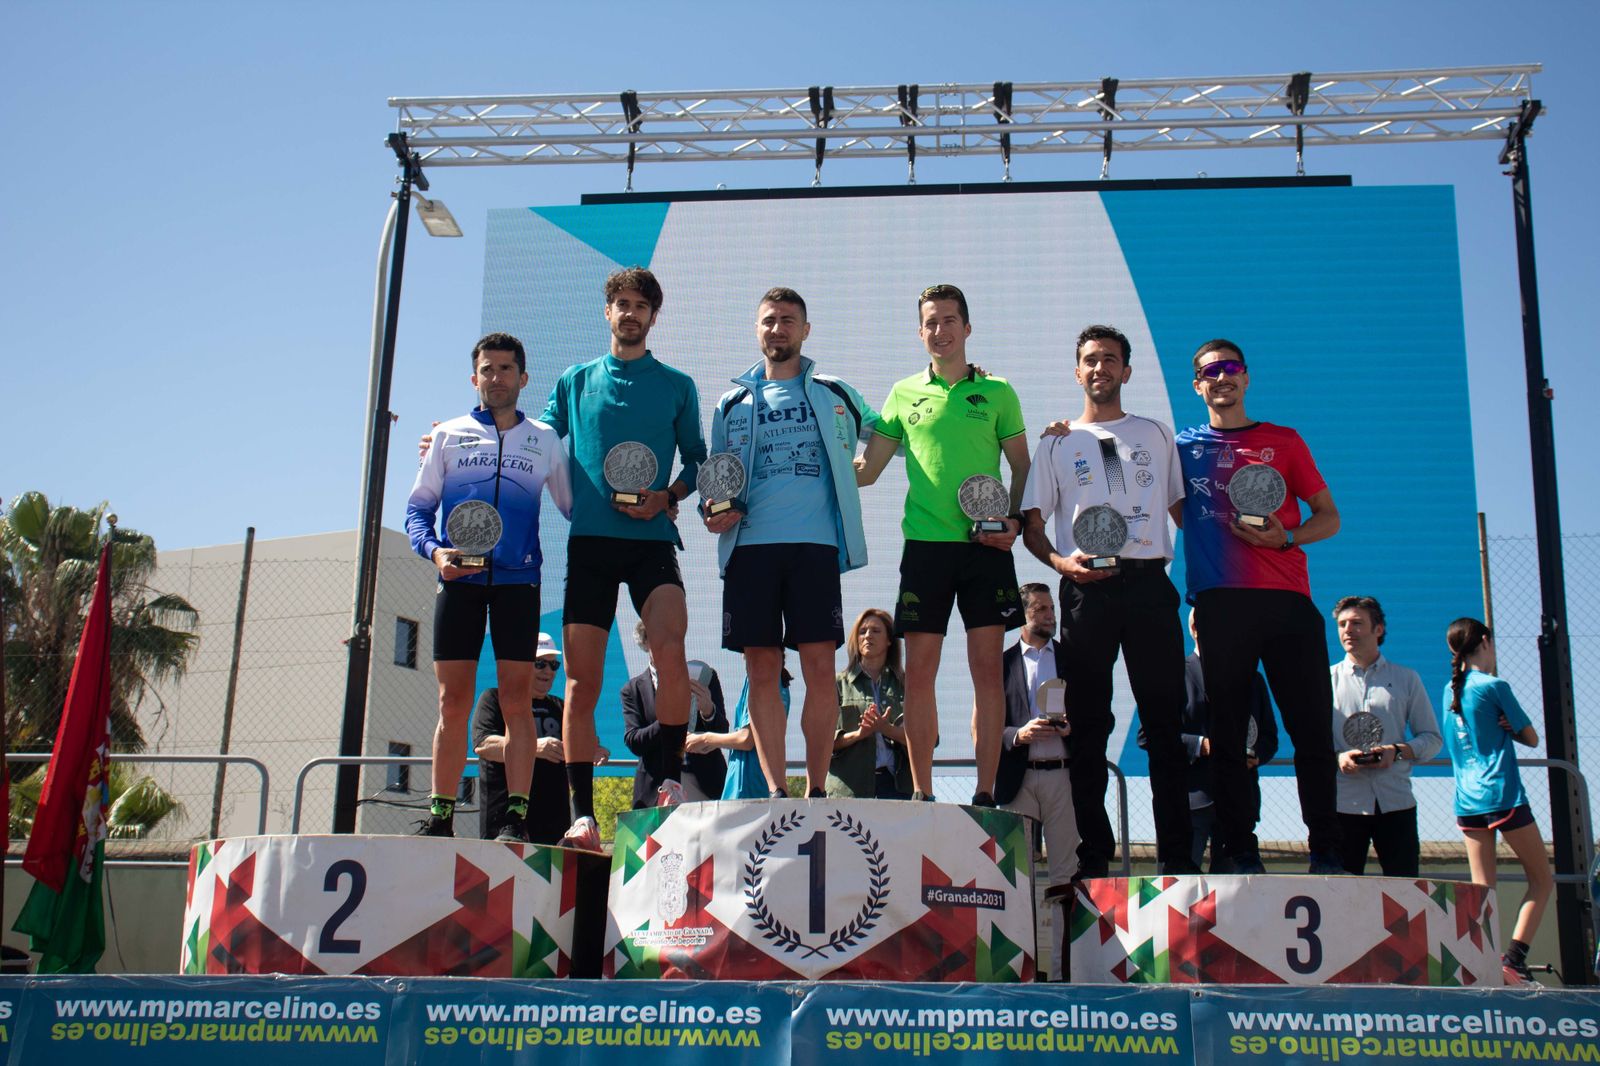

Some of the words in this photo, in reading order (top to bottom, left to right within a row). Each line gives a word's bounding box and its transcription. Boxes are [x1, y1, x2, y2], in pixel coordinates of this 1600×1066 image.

[763, 424, 817, 439] ATLETISMO
[457, 456, 534, 474] MARACENA
[966, 481, 995, 501] 18
[457, 508, 487, 528] 18
[1081, 512, 1112, 532] 18
[797, 830, 826, 934] 1
[319, 859, 367, 954] 2
[927, 889, 1004, 907] #Granada2031
[683, 927, 713, 936] GRANADA
[1284, 895, 1323, 974] 3
[55, 996, 381, 1023] www.mpmarcelino.es
[426, 1000, 762, 1028] www.mpmarcelino.es
[826, 1004, 1179, 1032] www.mpmarcelino.es
[1227, 1009, 1599, 1038] www.mpmarcelino.es
[51, 1018, 379, 1046] www.mpmarcelino.es
[424, 1022, 761, 1050] www.mpmarcelino.es
[826, 1027, 1180, 1056] www.mpmarcelino.es
[1230, 1033, 1600, 1062] www.mpmarcelino.es
